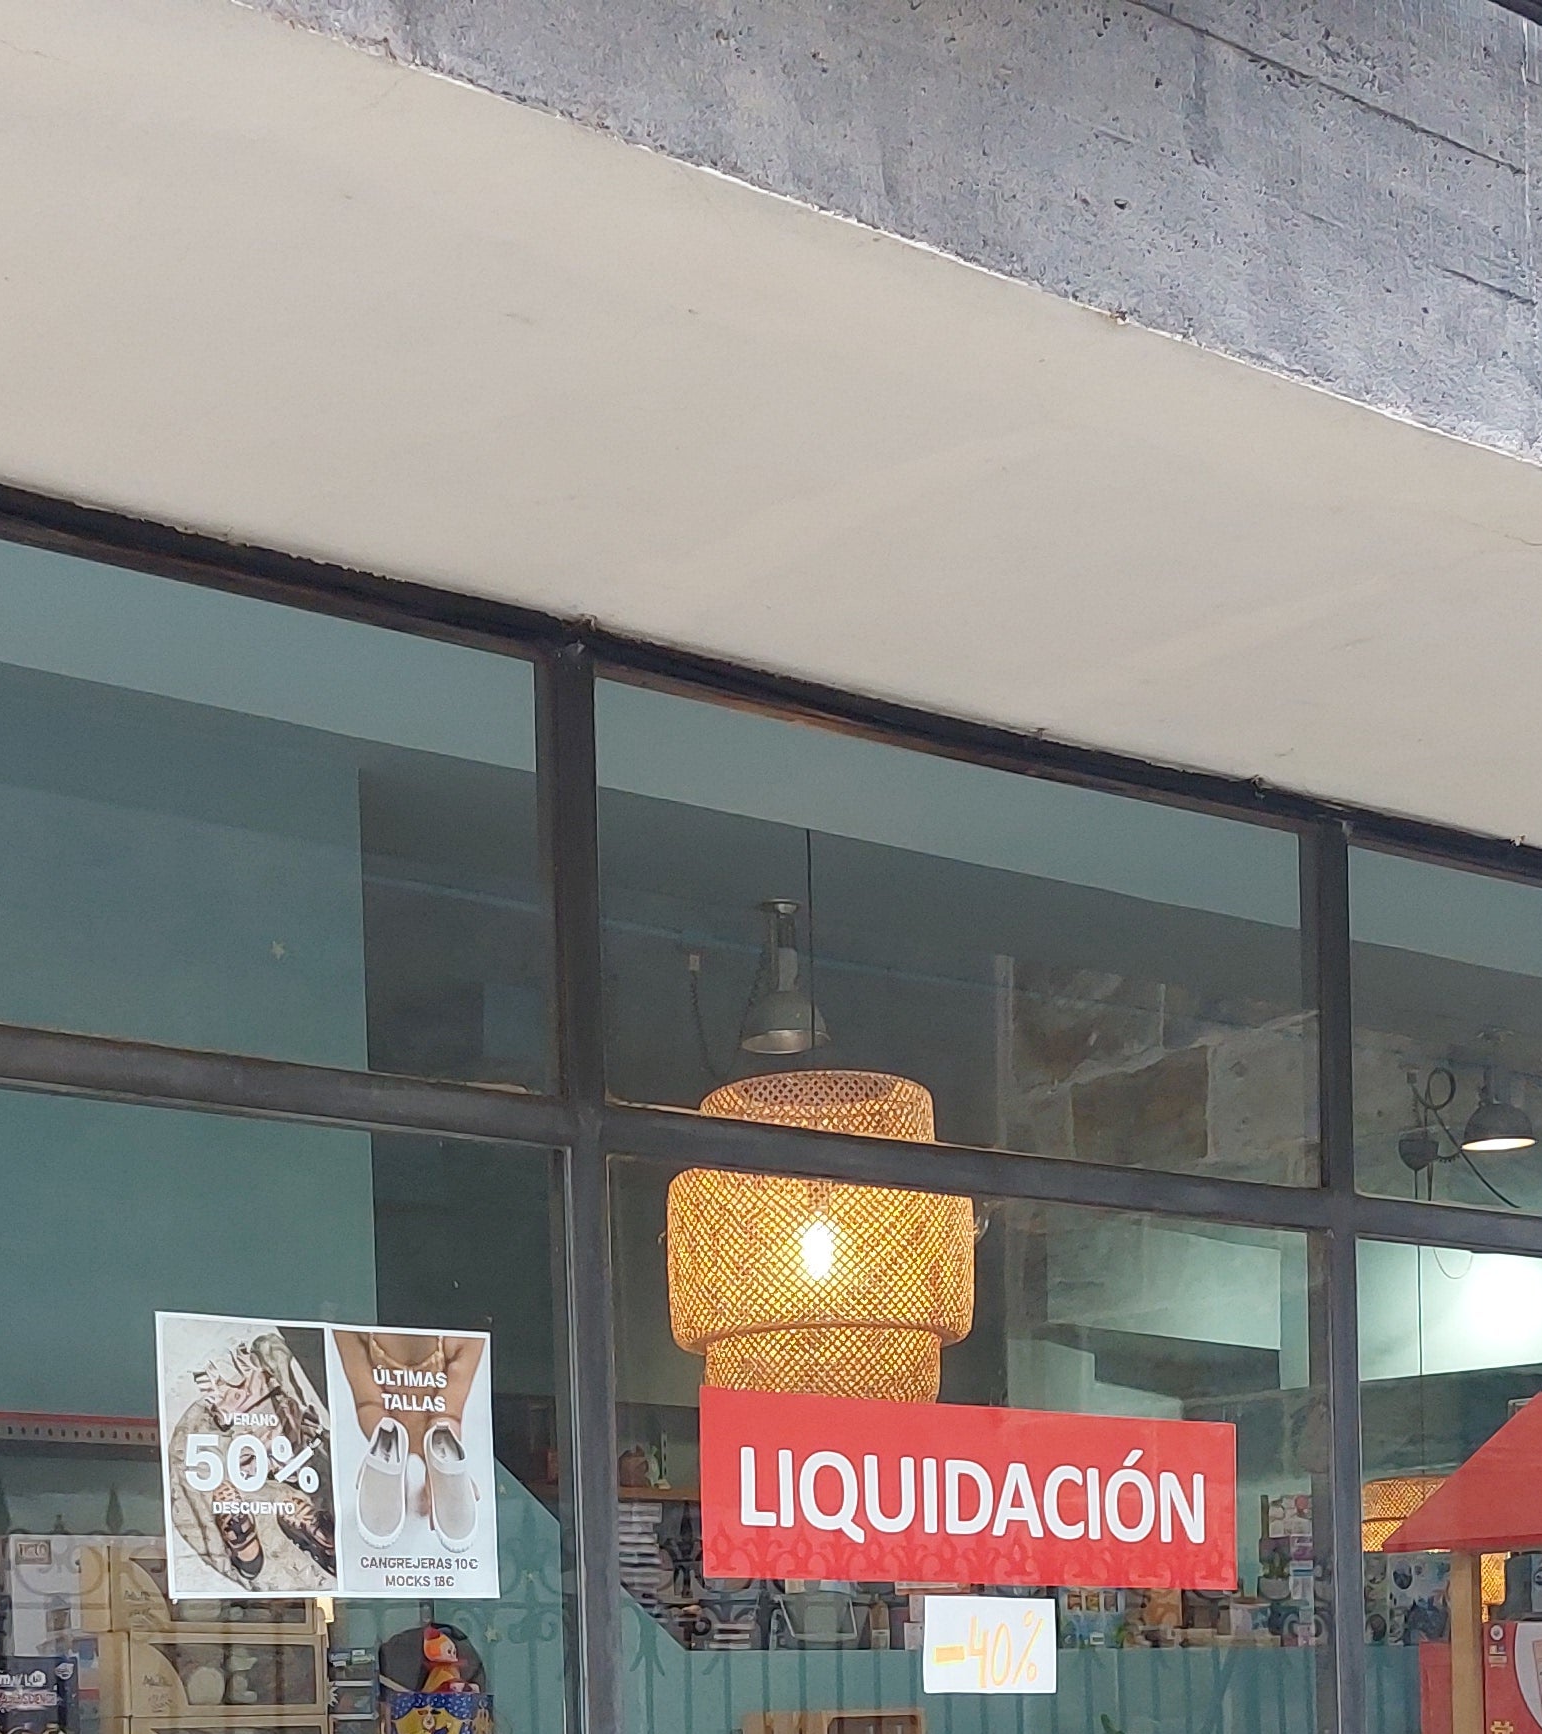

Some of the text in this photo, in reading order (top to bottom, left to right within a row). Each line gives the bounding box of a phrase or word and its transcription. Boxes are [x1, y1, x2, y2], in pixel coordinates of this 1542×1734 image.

[373, 1364, 448, 1389] ÚLTIMAS
[381, 1391, 447, 1413] TALLAS
[224, 1412, 279, 1427] VERANO
[184, 1433, 320, 1494] 50%
[739, 1447, 1206, 1545] LIQUIDACIÓN
[212, 1501, 297, 1516] DESCUENTO
[360, 1556, 479, 1571] CANGREJERAS 10€
[385, 1575, 455, 1588] MOCKS 18€
[932, 1610, 1044, 1689] -40%
